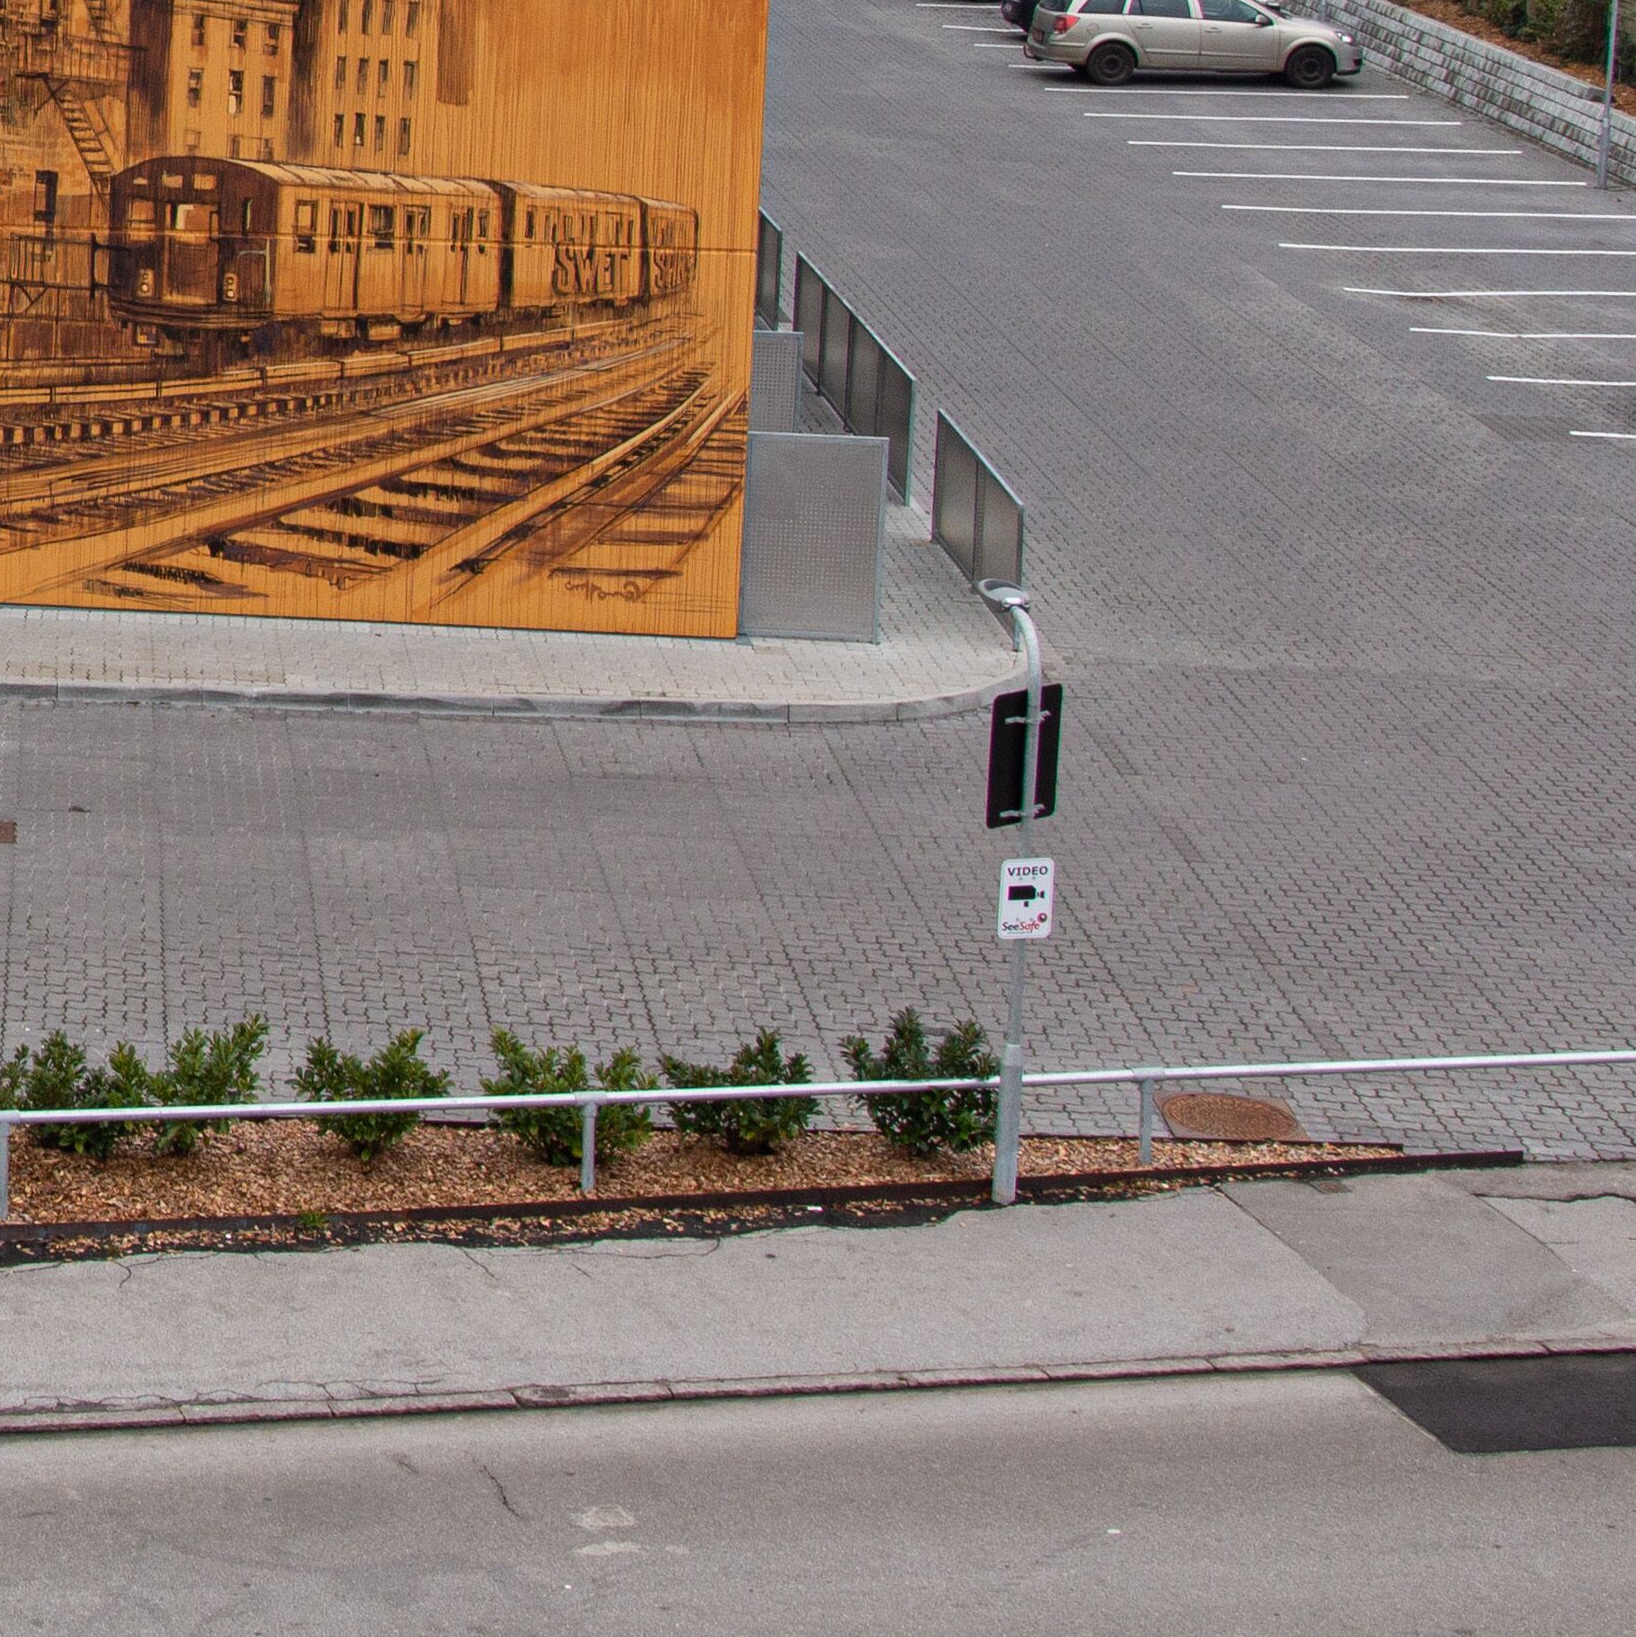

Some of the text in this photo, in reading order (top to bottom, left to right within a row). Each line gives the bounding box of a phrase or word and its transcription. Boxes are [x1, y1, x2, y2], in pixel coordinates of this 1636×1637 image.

[552, 236, 631, 296] SWET
[1007, 865, 1048, 876] VIDEO
[1001, 920, 1040, 933] SeeSafe
